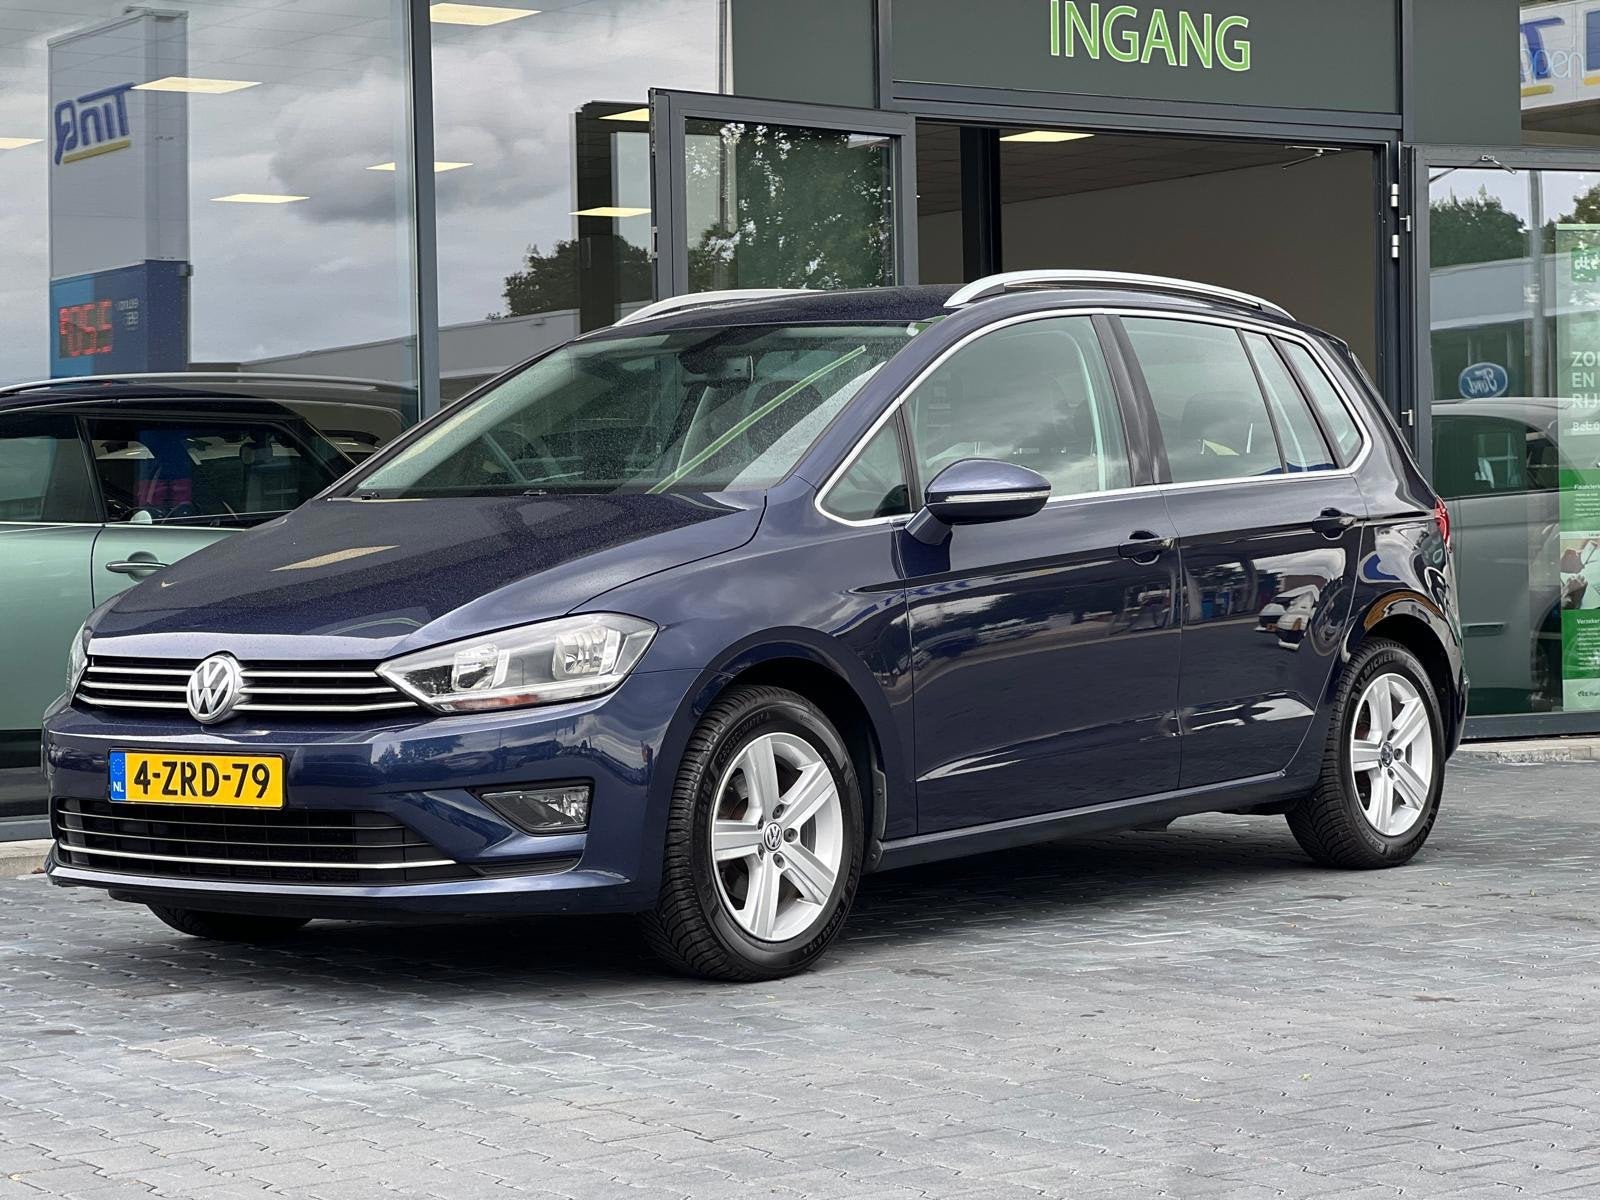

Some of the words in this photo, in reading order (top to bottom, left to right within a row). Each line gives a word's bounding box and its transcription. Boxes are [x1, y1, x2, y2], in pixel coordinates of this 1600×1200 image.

[1050, 0, 1250, 71] INGANG
[1571, 351, 1600, 367] ZO
[1572, 371, 1595, 388] EN
[1572, 392, 1600, 409] RIJ
[113, 781, 124, 793] NL
[133, 760, 270, 799] 4-ZRD-79
